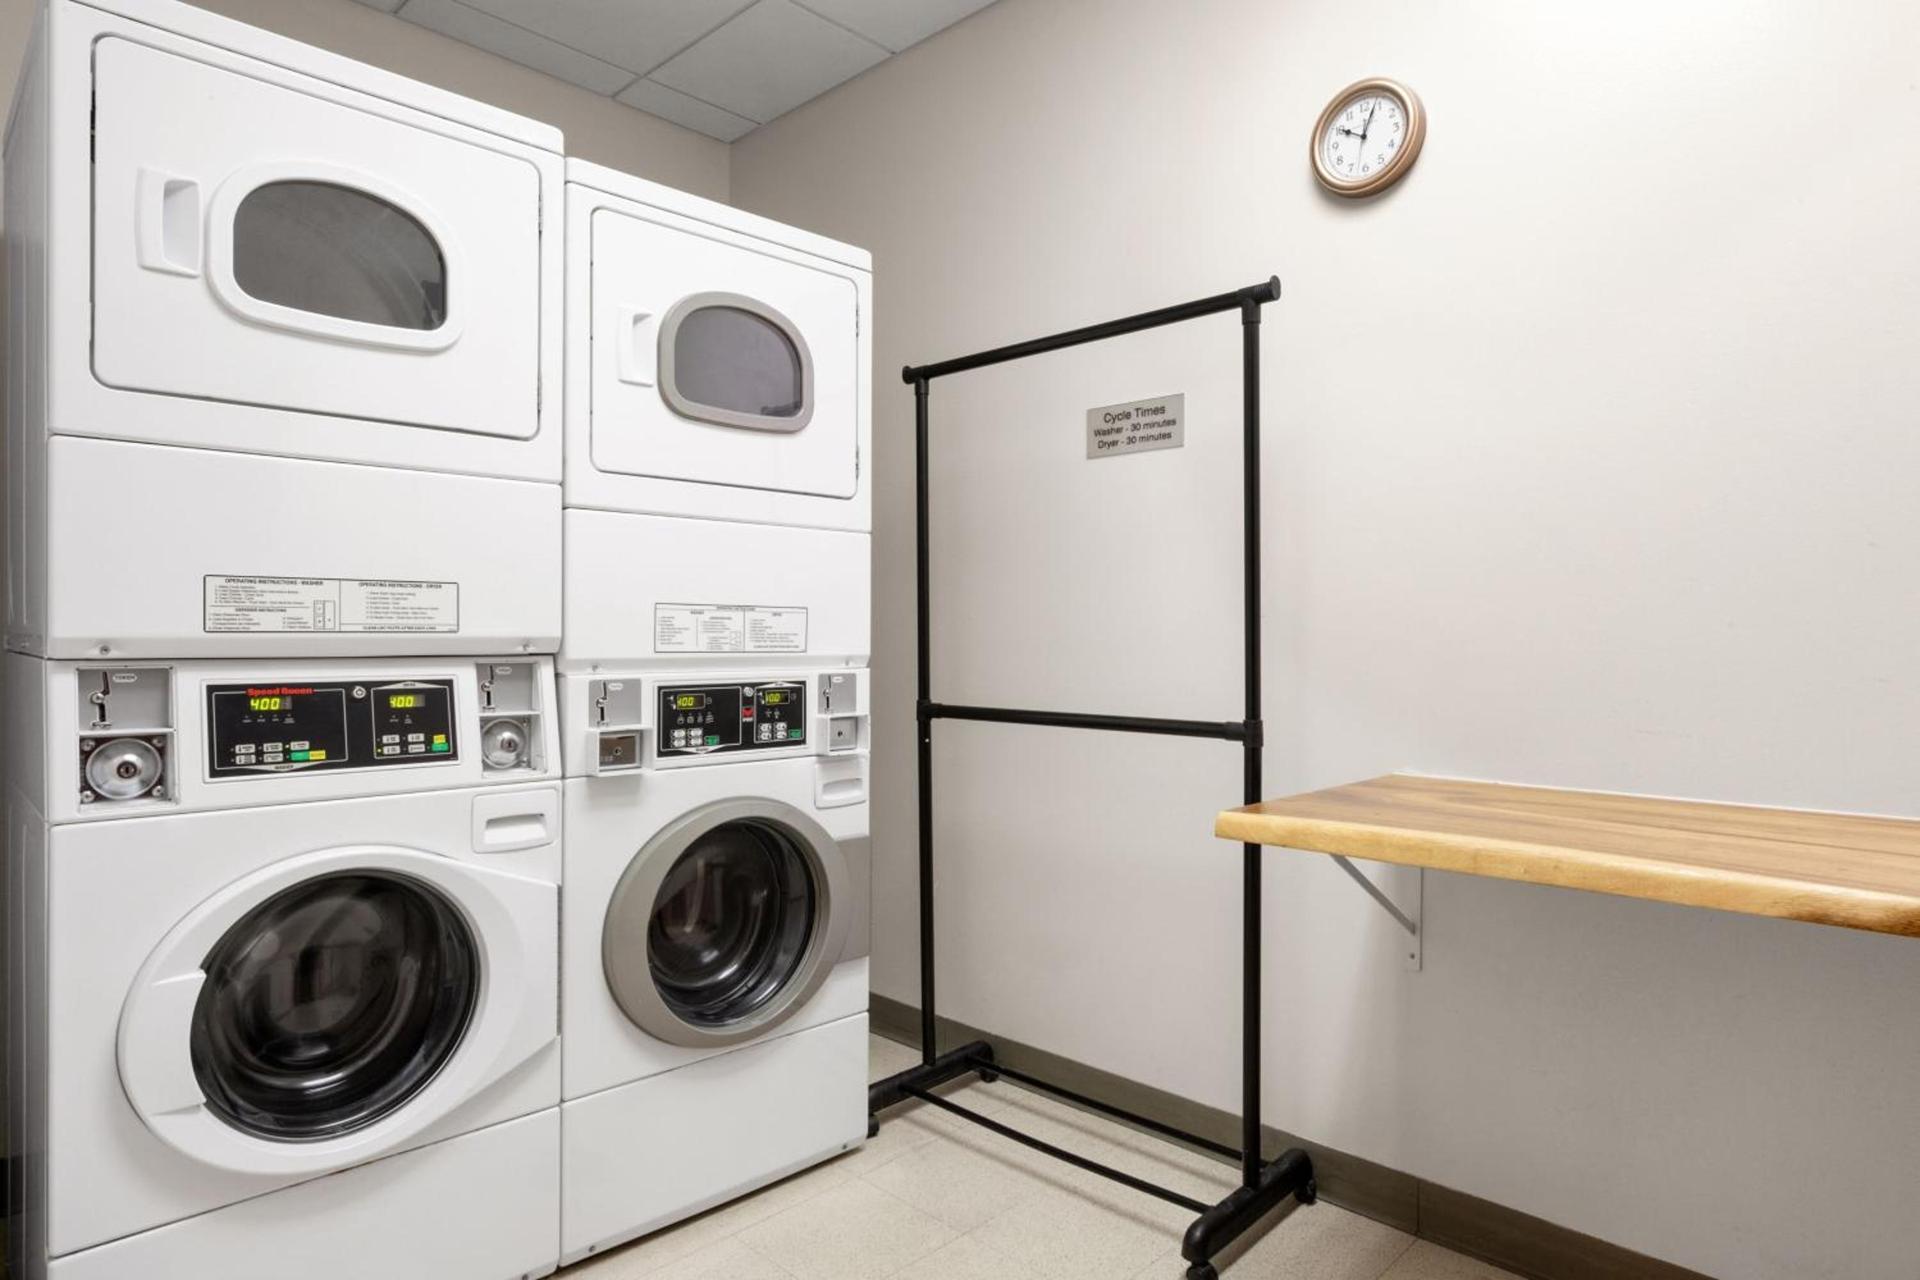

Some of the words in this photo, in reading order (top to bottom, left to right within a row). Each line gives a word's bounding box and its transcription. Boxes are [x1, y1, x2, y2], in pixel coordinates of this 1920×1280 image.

[1360, 101, 1370, 113] 12
[1346, 111, 1354, 121] 11
[1388, 108, 1396, 118] 2
[1392, 121, 1400, 133] 3
[1332, 141, 1340, 152] 9
[1388, 138, 1394, 148] 4
[1336, 155, 1344, 166] 8
[1377, 154, 1384, 164] 5
[1348, 163, 1354, 173] 7
[1362, 164, 1370, 172] 6
[1104, 410, 1132, 424] Cycle
[1134, 406, 1166, 418] Times
[1094, 426, 1124, 437] Washer
[1130, 422, 1141, 432] 30
[1142, 418, 1177, 430] minutes
[1098, 439, 1120, 449] Dryer
[1126, 436, 1137, 445] 30
[1138, 432, 1172, 442] minutes
[248, 688, 280, 697] Speed
[281, 687, 313, 695] Queen
[250, 697, 280, 710] 400
[389, 695, 414, 708] 400
